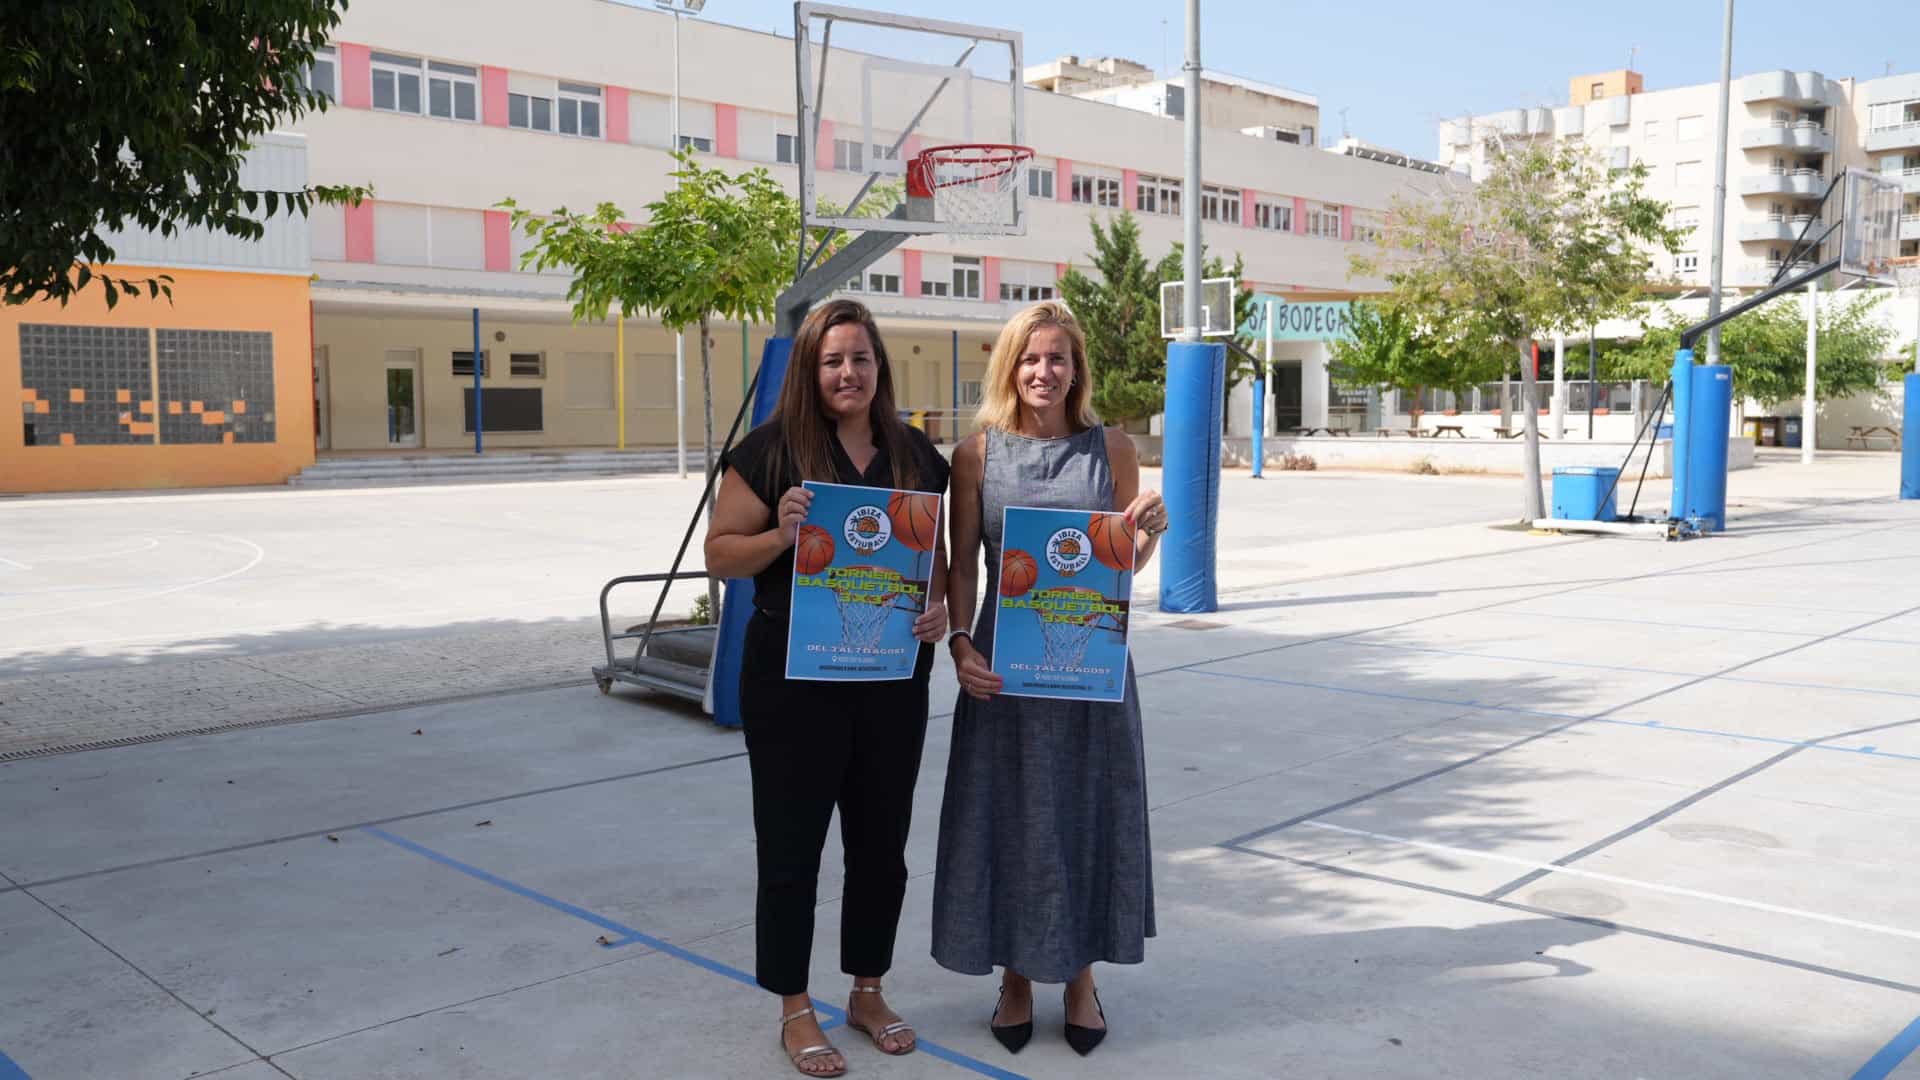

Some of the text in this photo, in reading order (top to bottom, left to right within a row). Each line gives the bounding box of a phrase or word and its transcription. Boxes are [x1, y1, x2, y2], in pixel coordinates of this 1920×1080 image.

[1248, 302, 1268, 331] SA
[857, 507, 882, 519] IBIZA
[847, 532, 887, 549] ESTIUBALL
[1058, 530, 1082, 541] IBIZA
[1049, 554, 1088, 570] ESTIUBALL
[824, 567, 901, 581] TORNEIG
[797, 576, 925, 595] BASQUETBOL
[1029, 589, 1102, 601] TORNEIG
[1001, 598, 1126, 615] BASQUETBOL
[807, 644, 828, 653] DEL
[1009, 663, 1032, 671] DEL
